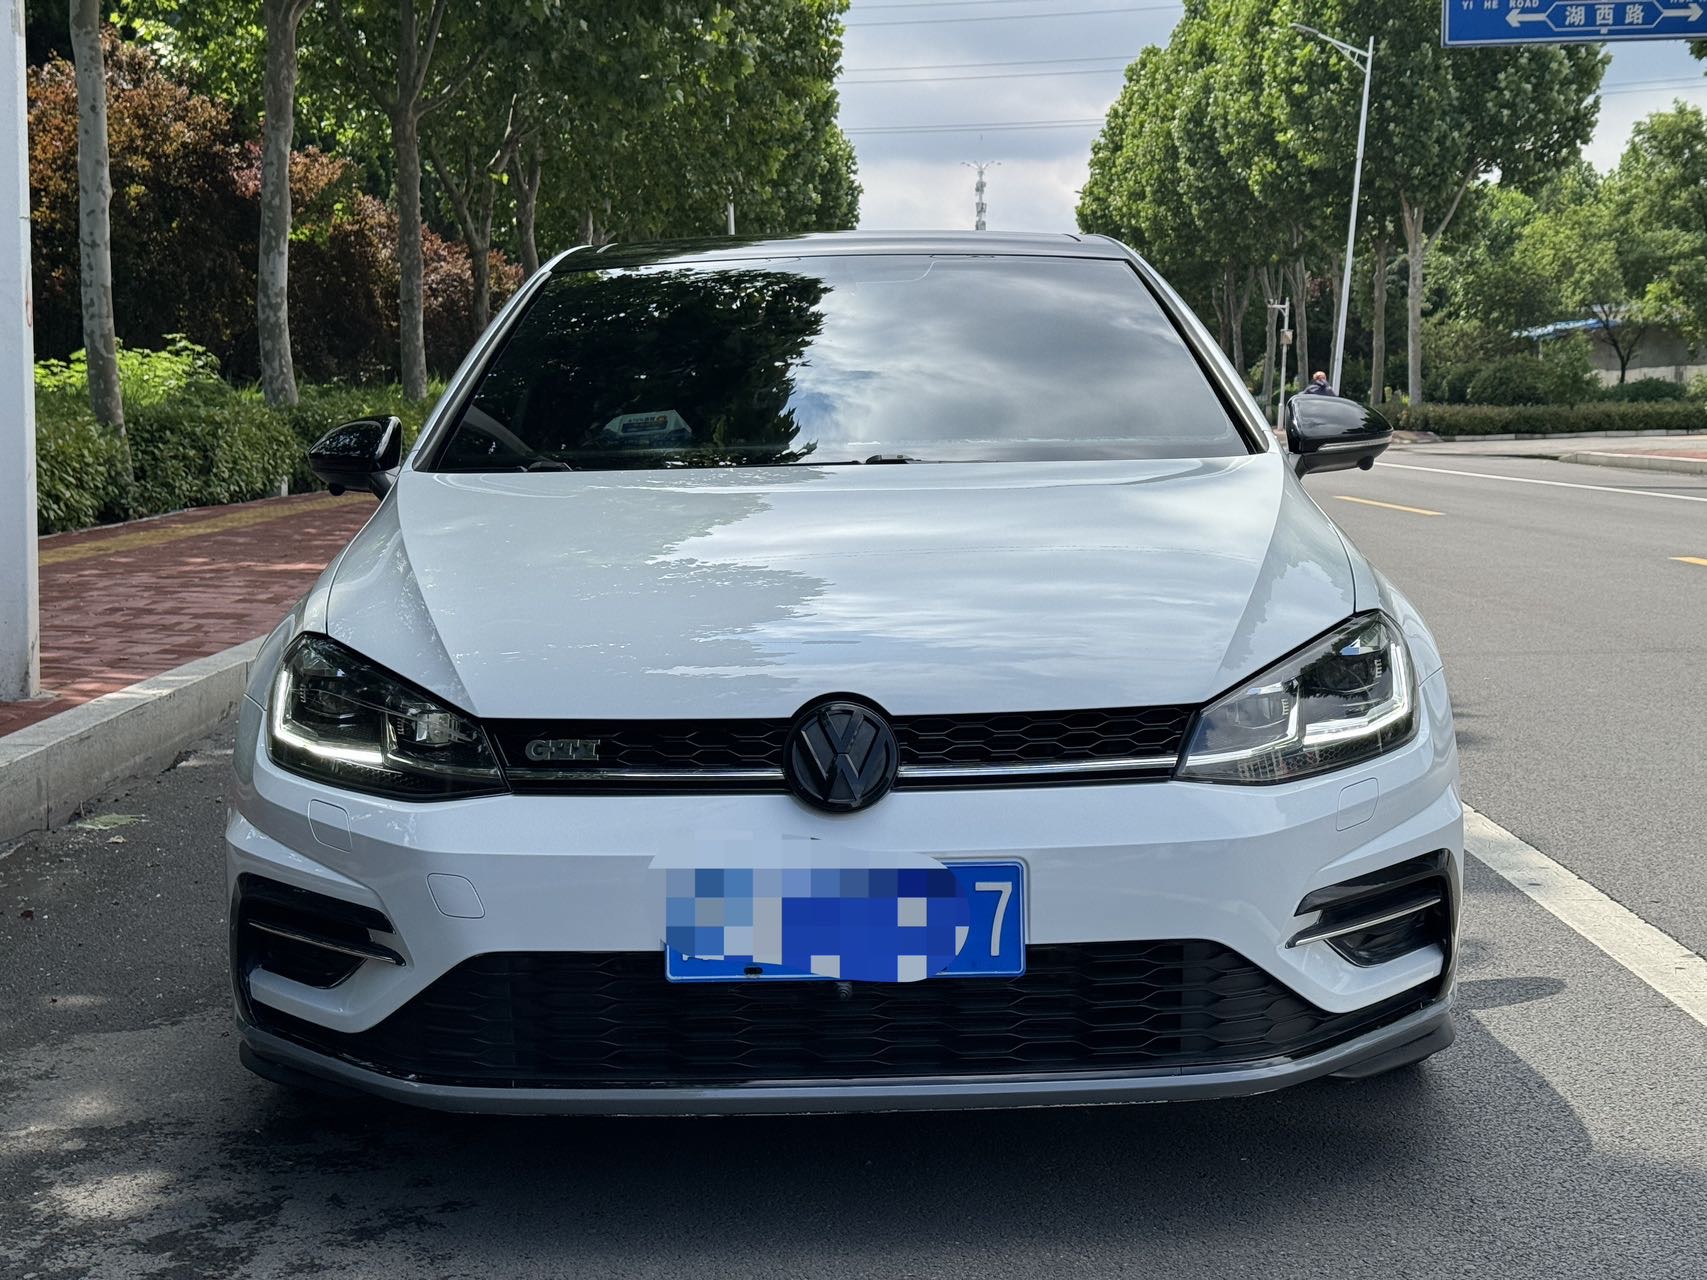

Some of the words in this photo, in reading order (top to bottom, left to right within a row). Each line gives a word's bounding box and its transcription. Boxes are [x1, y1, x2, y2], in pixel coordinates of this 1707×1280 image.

[1461, 0, 1474, 10] YI
[1483, 0, 1499, 9] HE
[1508, 0, 1540, 8] ROAD
[1564, 4, 1645, 26] 湖西路
